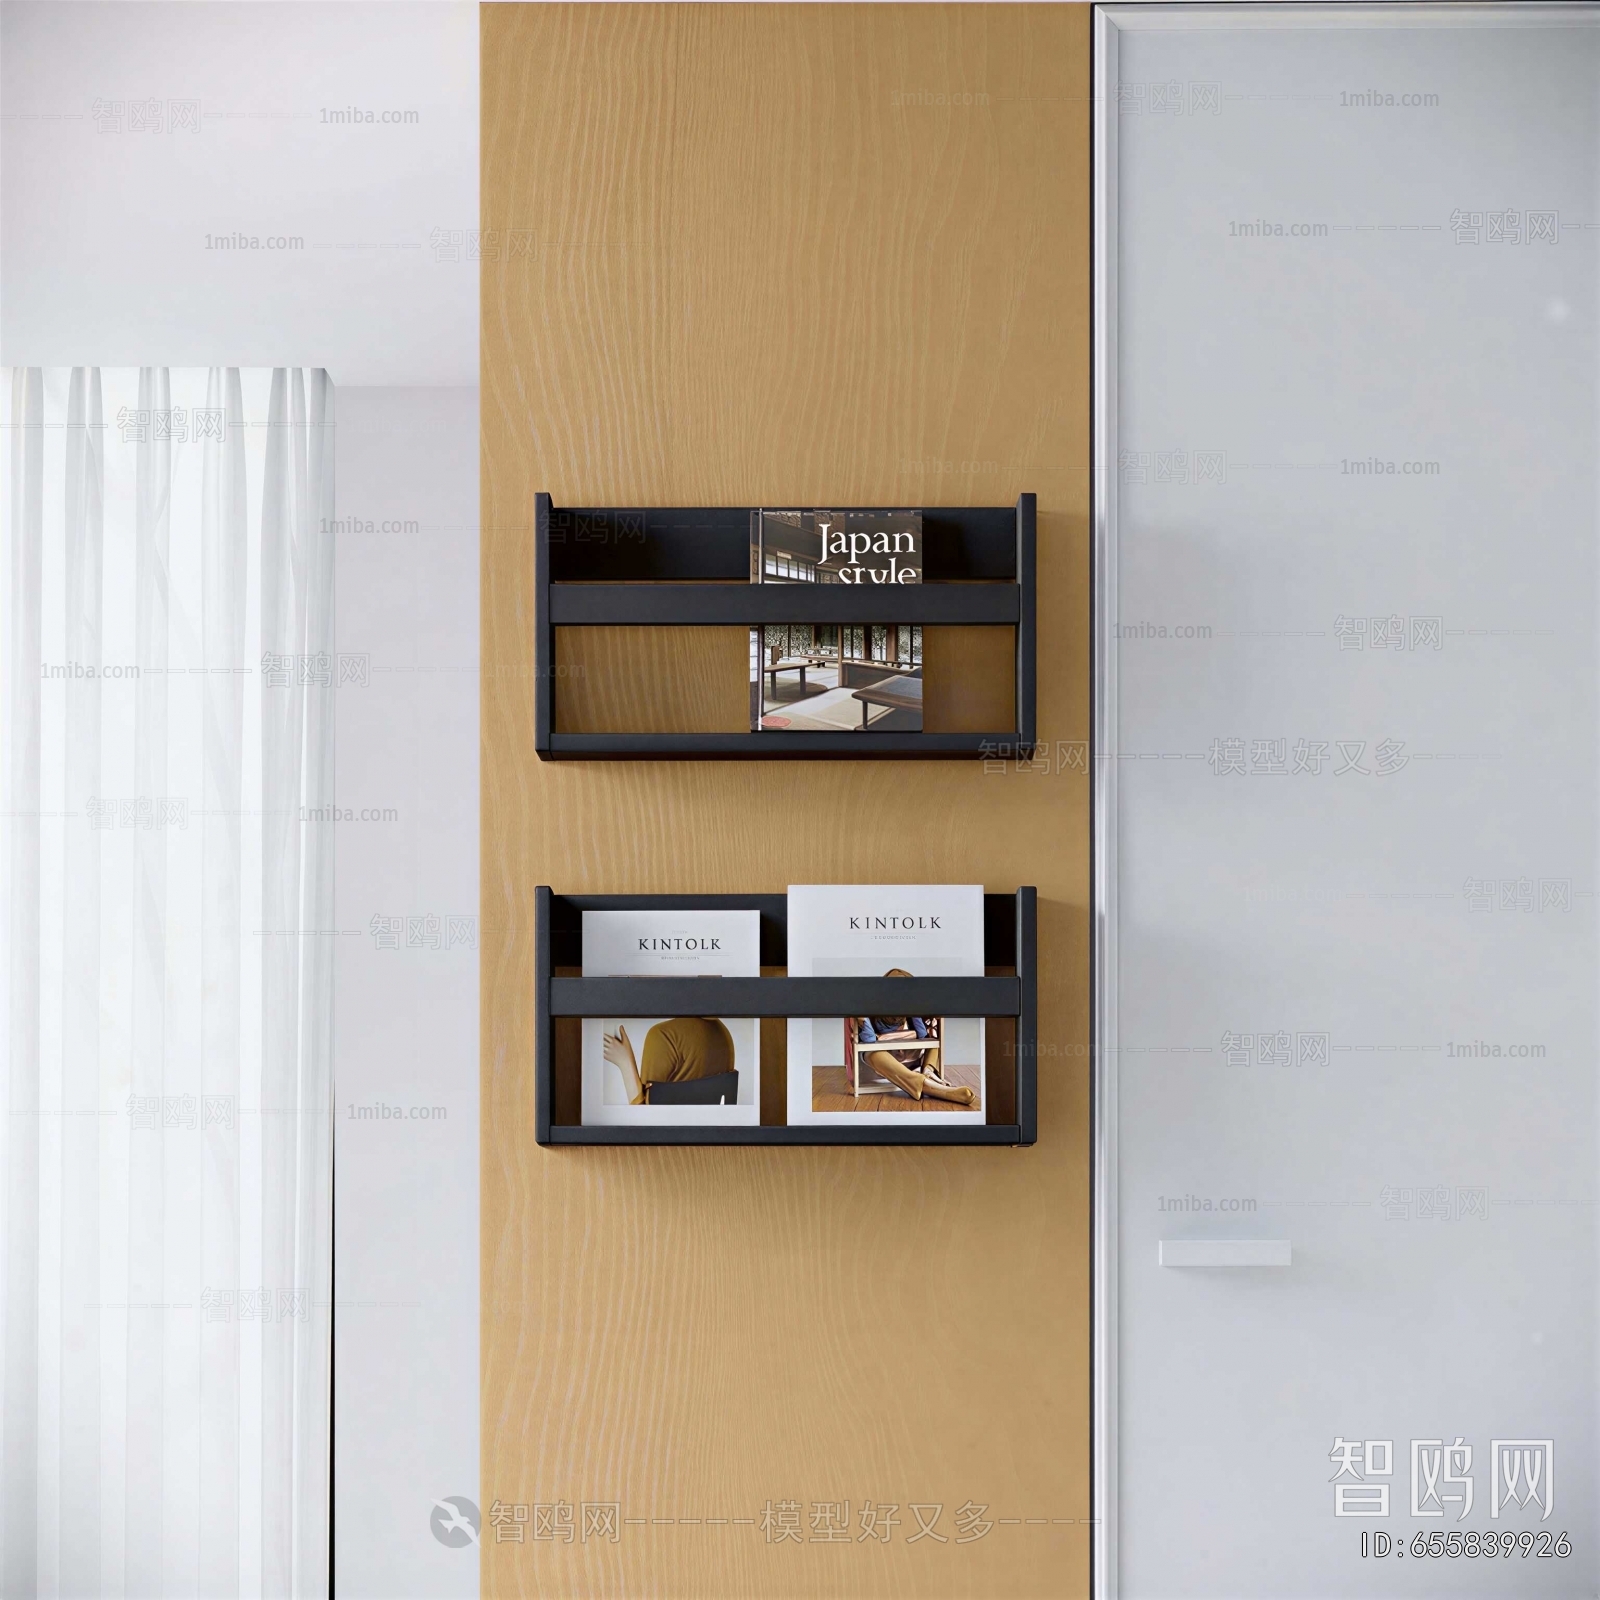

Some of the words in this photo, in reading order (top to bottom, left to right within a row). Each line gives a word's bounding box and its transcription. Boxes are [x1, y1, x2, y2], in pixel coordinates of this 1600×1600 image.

[817, 523, 917, 565] Japan
[849, 916, 942, 930] KINTOLK
[638, 938, 722, 951] KINTOLK
